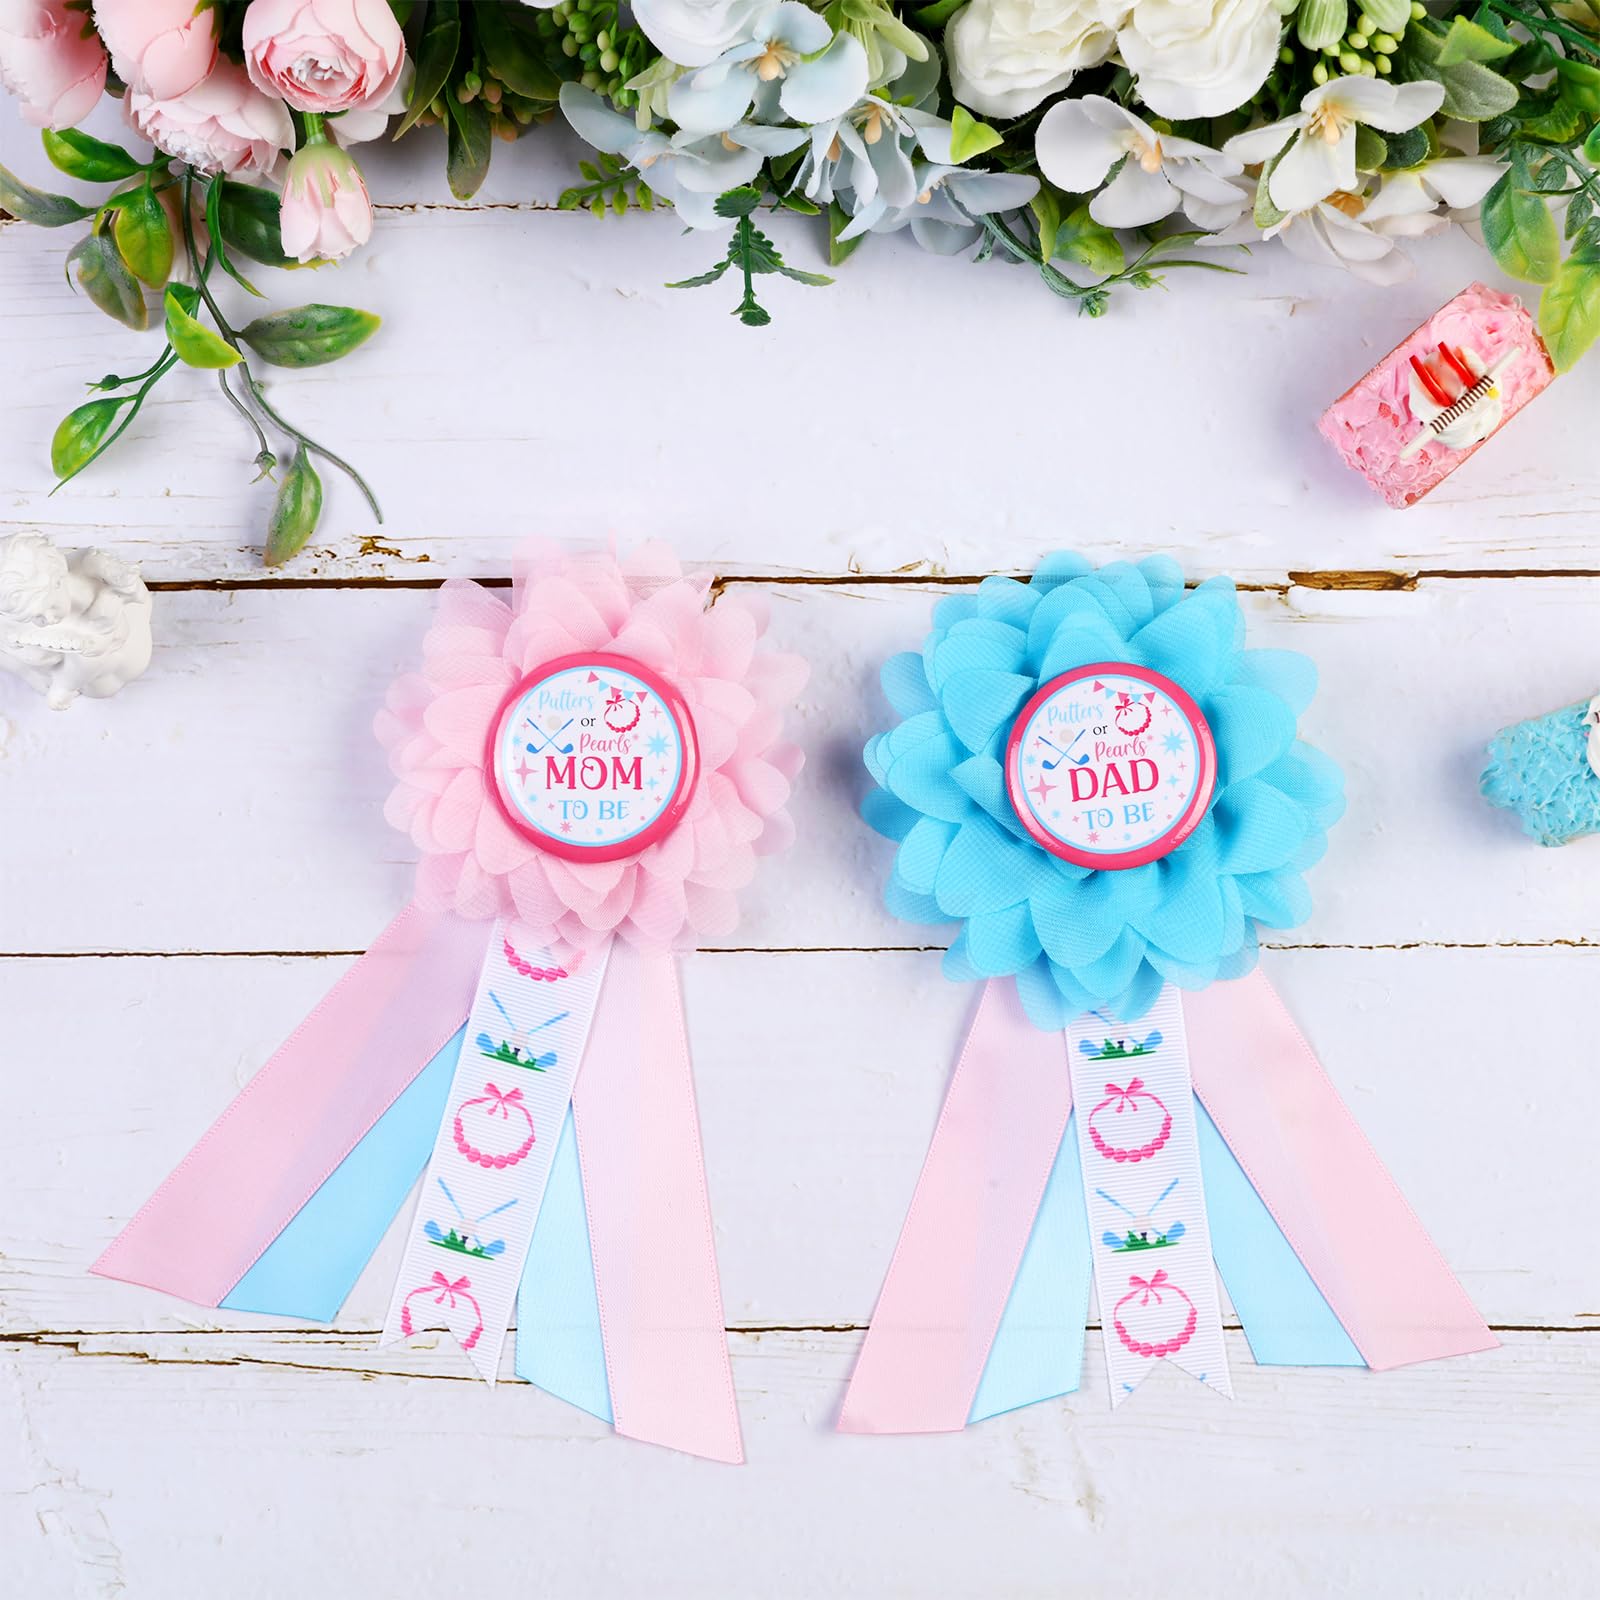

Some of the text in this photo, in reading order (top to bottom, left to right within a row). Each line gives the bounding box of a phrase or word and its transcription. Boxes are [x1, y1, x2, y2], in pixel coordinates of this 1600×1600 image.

[537, 689, 594, 711] Putters
[580, 717, 596, 727] or
[1047, 701, 1104, 726] Putters
[1092, 724, 1108, 736] or
[579, 733, 631, 754] Pearls
[1094, 737, 1146, 762] Pearls
[545, 756, 643, 790] MOM
[1068, 758, 1159, 802] DAD
[558, 800, 630, 820] TO BE
[1081, 802, 1155, 830] TO BE
